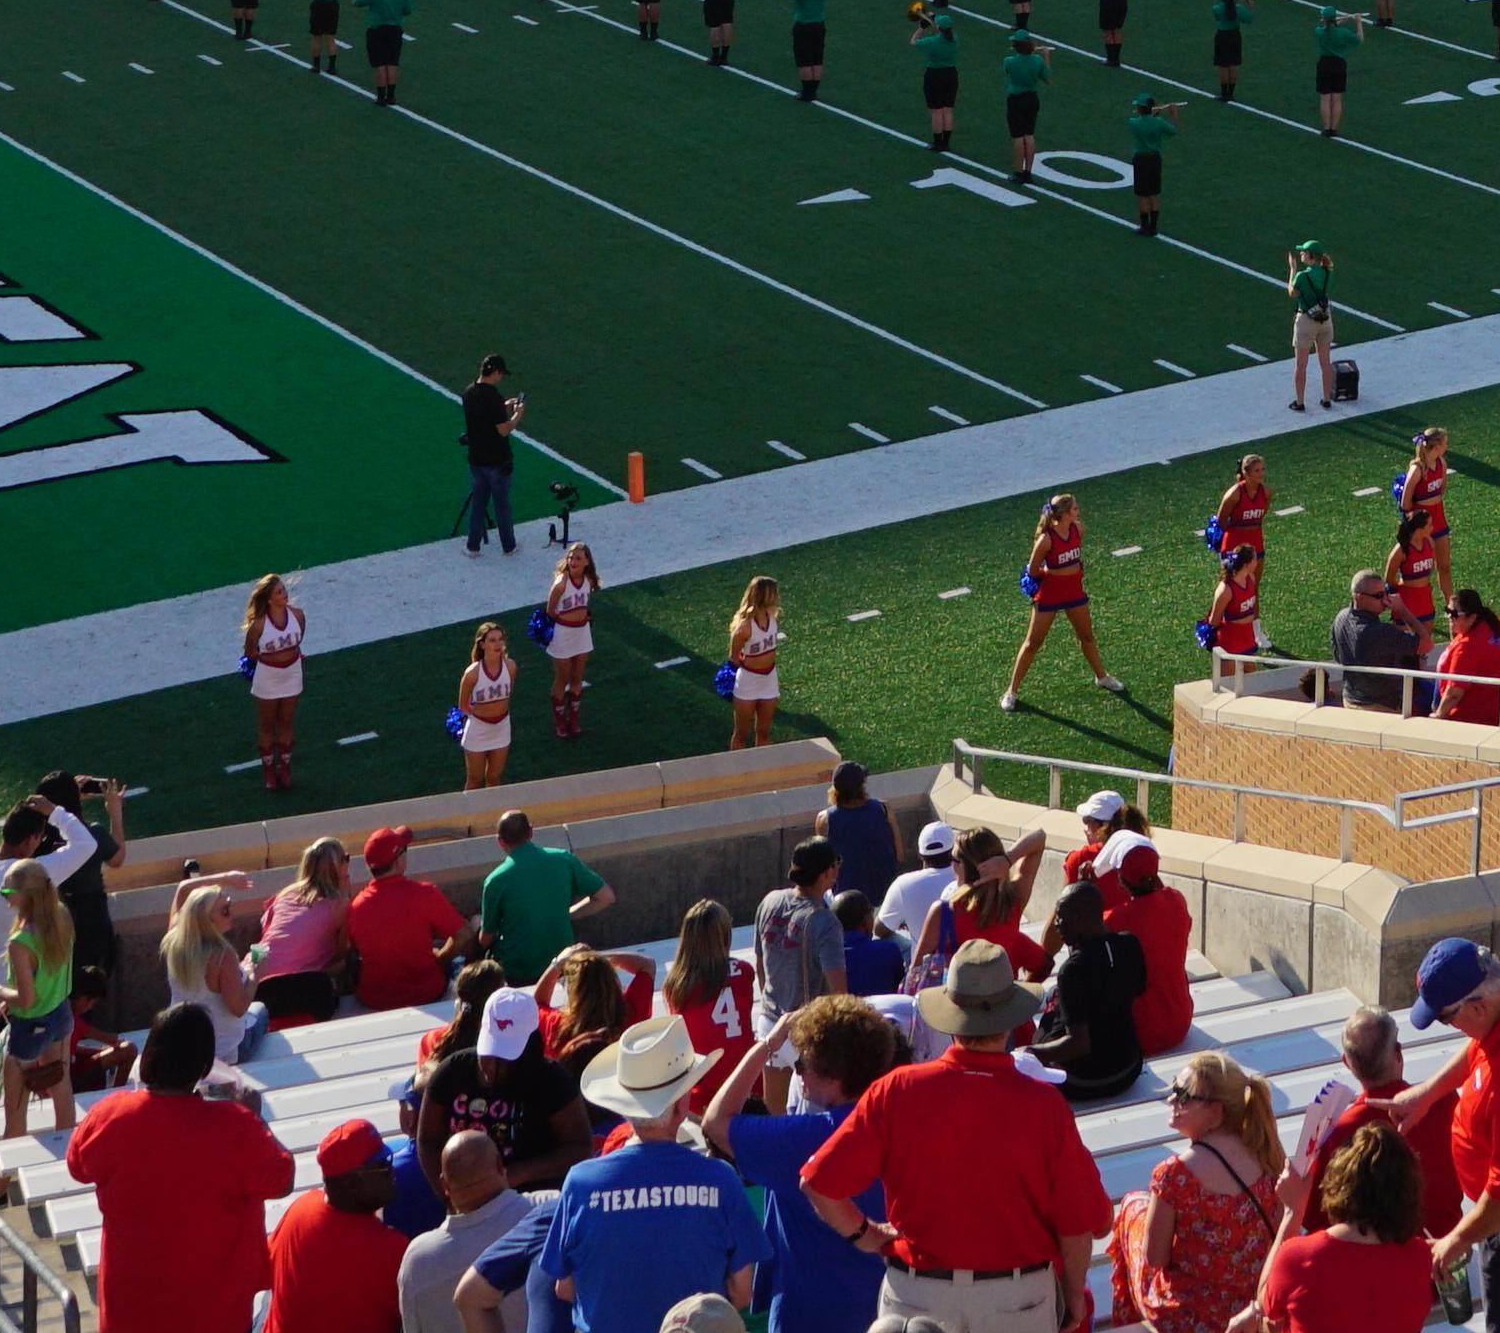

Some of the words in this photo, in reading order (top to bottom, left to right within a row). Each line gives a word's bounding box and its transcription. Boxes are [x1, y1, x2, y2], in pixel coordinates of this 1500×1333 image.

[909, 150, 1136, 207] 10
[1057, 546, 1081, 565] SMU
[711, 988, 743, 1039] 4
[588, 1185, 719, 1212] #TEXASTOUGH
